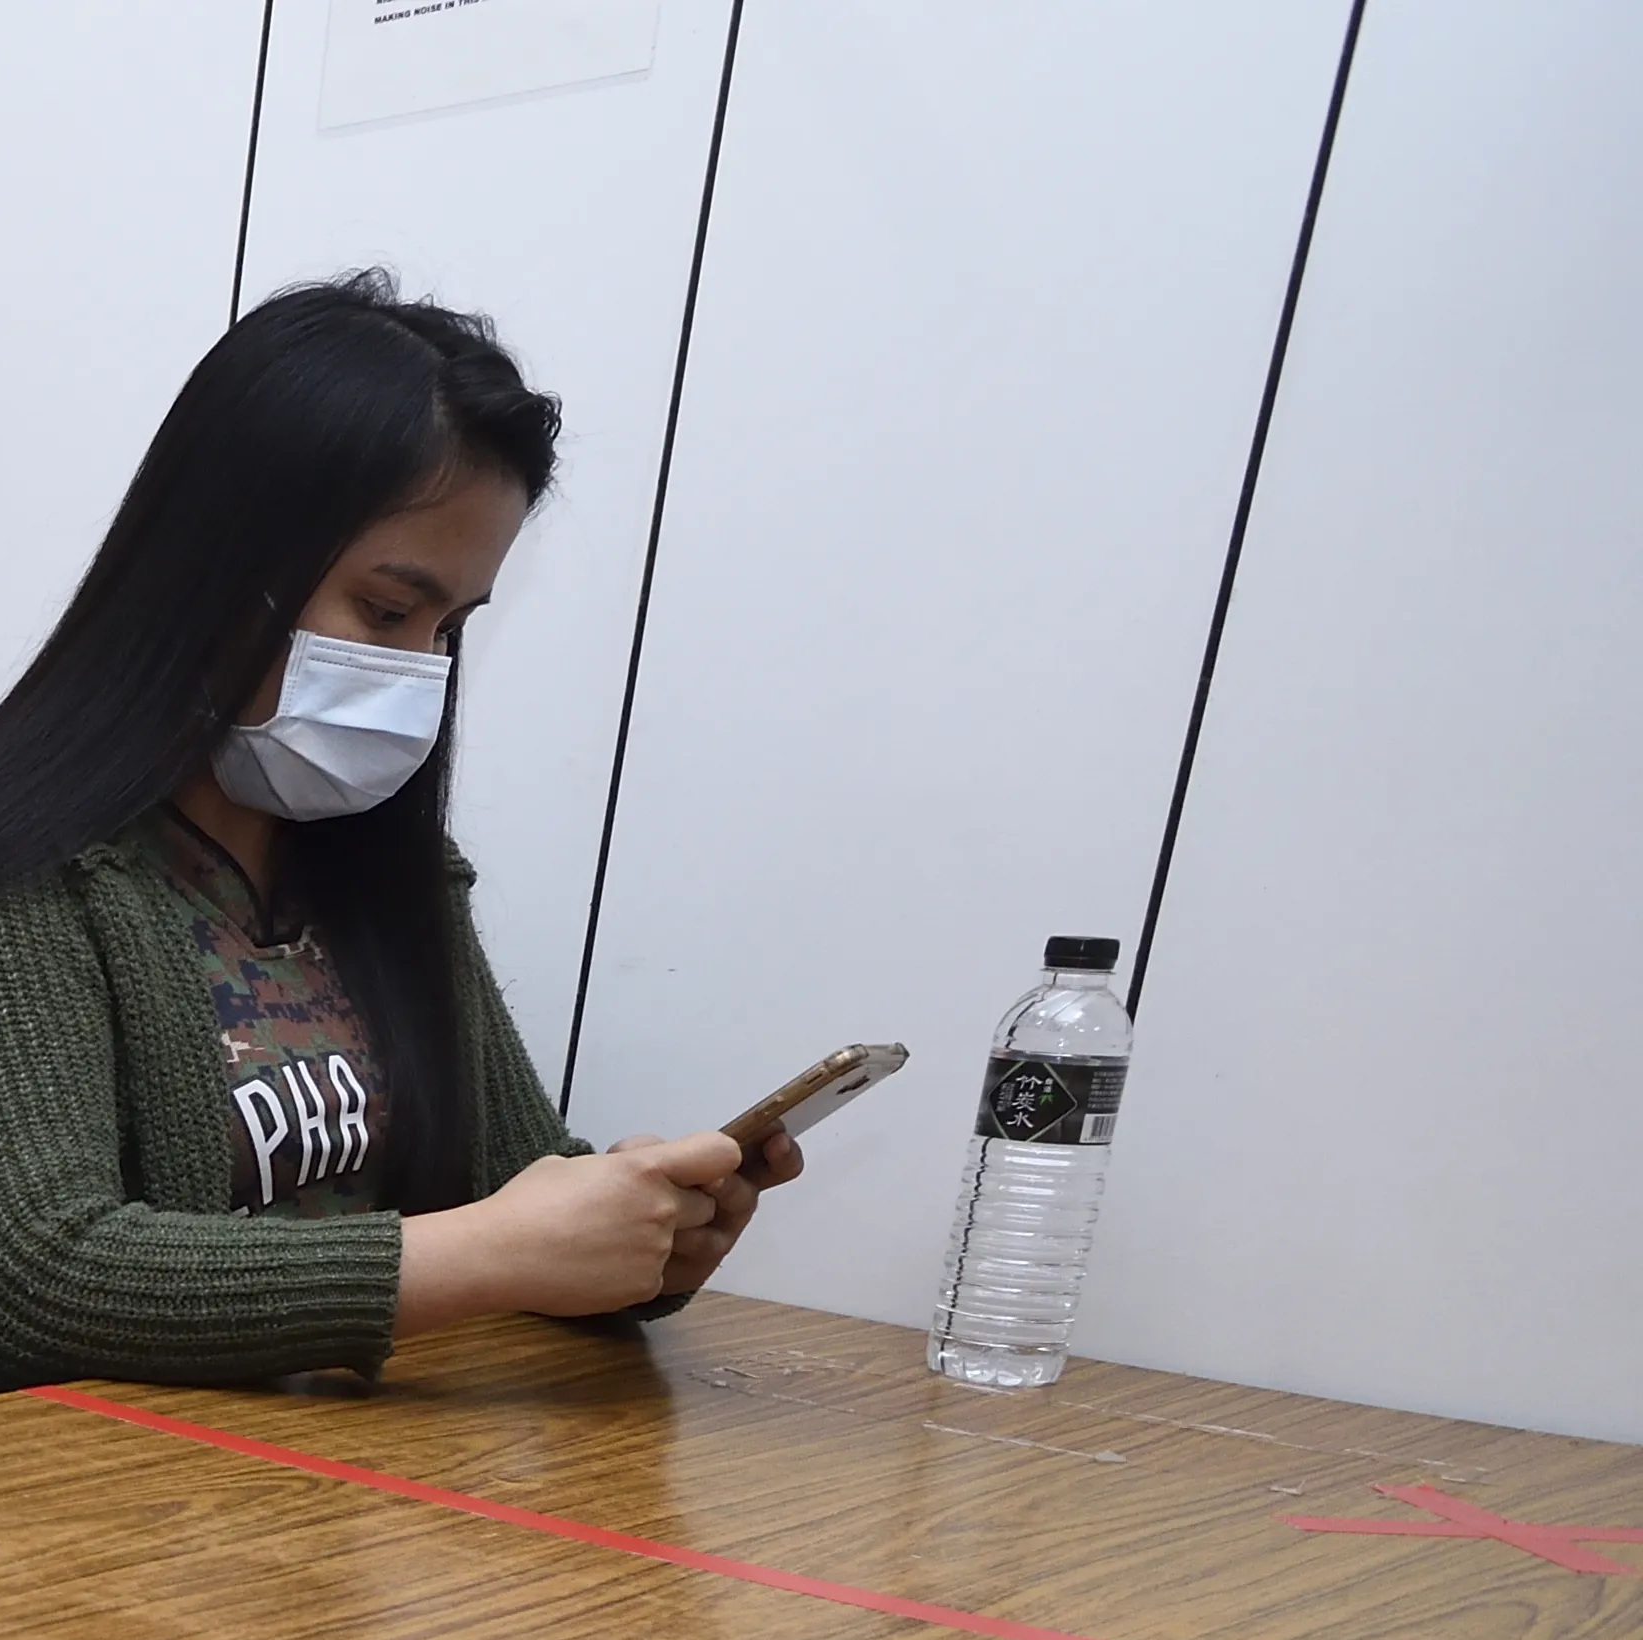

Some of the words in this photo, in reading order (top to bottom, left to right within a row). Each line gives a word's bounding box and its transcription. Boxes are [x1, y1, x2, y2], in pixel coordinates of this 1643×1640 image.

[374, 10, 410, 23] MAKING
[414, 4, 441, 15] NOISE
[445, 1, 454, 9] IN
[1006, 1075, 1043, 1128] 竹炭水
